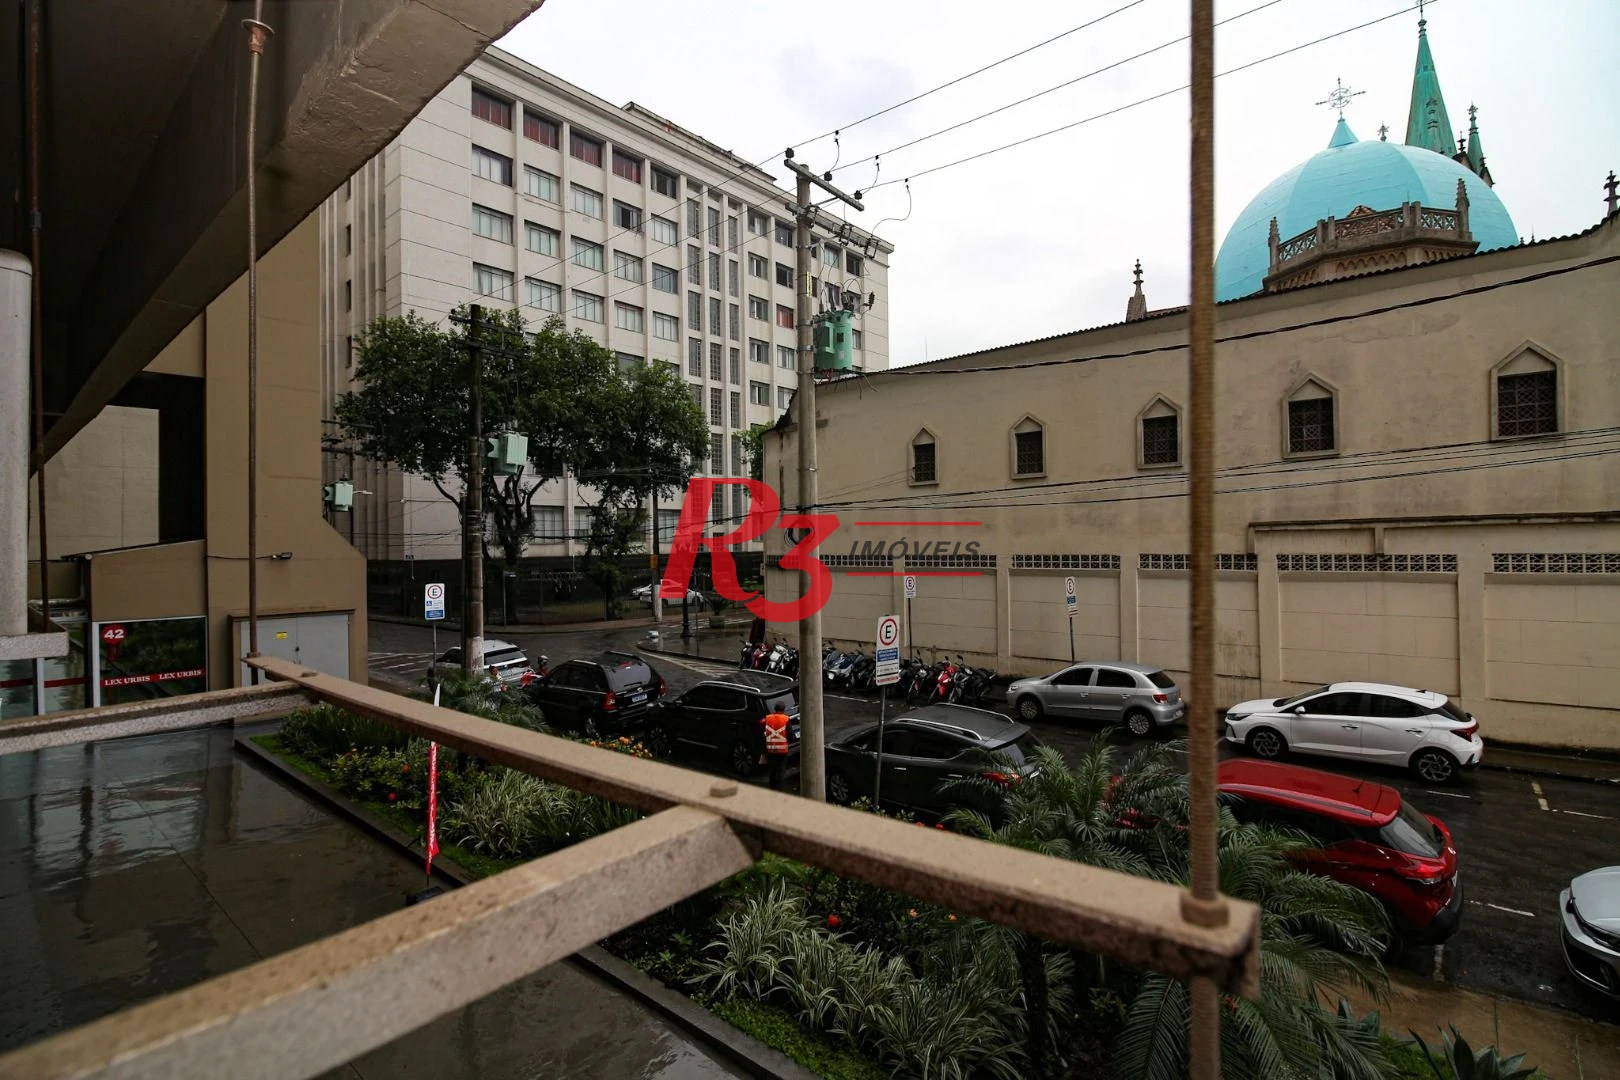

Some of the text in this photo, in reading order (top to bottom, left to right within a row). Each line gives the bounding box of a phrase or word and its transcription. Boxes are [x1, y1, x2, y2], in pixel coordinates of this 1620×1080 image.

[104, 628, 124, 639] 42
[885, 625, 892, 639] E
[124, 675, 151, 684] URBIS
[159, 670, 202, 680] LEX URBIS
